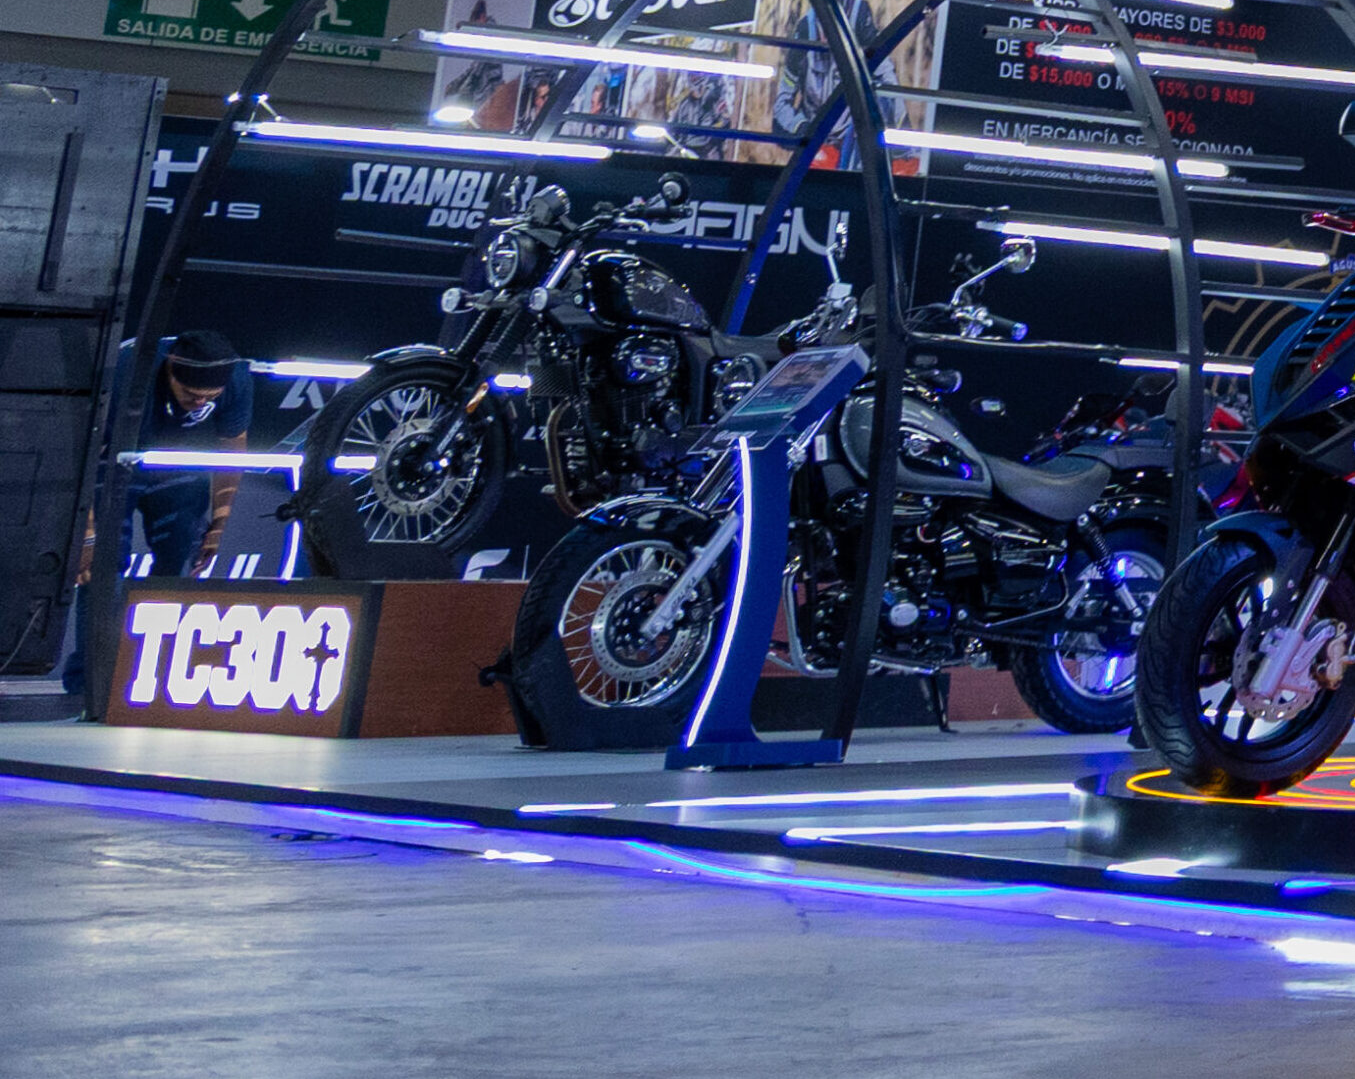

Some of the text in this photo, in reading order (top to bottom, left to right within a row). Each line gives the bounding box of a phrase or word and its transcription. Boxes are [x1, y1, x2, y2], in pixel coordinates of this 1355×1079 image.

[117, 18, 195, 41] SALIDA
[200, 27, 228, 44] DE
[1112, 6, 1186, 31] AYORES
[1190, 17, 1213, 34] DE
[996, 38, 1021, 57] DE
[999, 61, 1025, 80] DE
[1098, 72, 1112, 90] O
[1157, 79, 1191, 100] 15%
[1224, 86, 1255, 106] MSI
[983, 119, 1008, 138] EN
[1165, 110, 1197, 135] 0%
[130, 602, 351, 712] TC300
